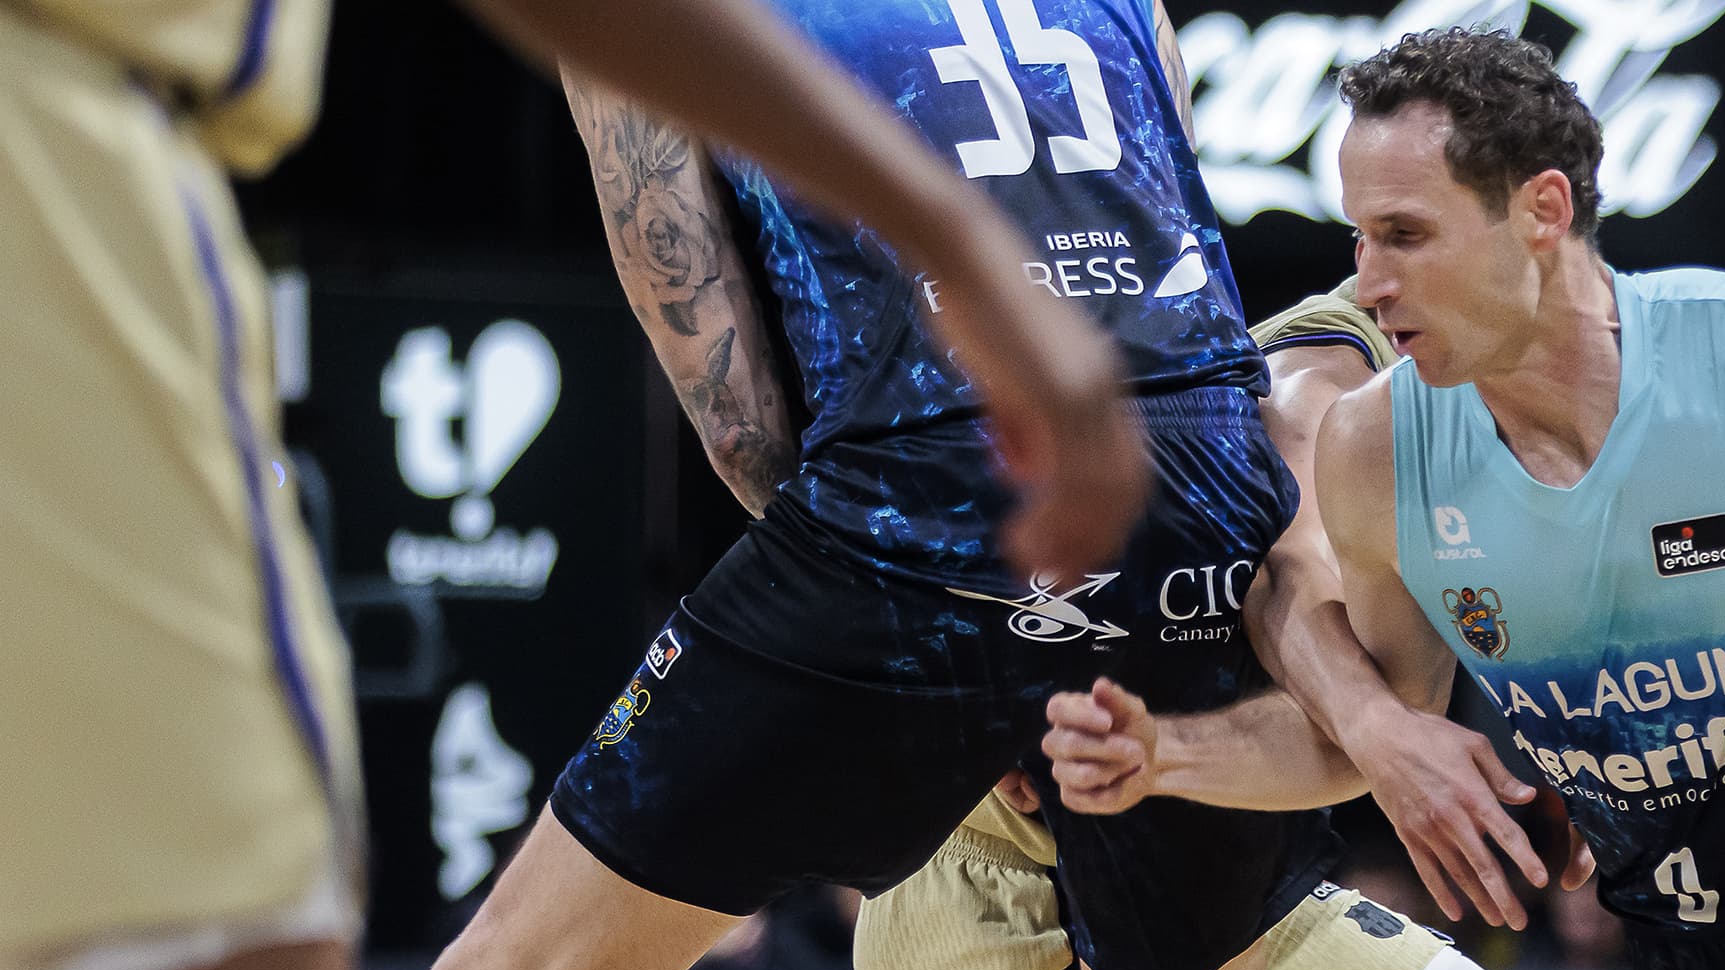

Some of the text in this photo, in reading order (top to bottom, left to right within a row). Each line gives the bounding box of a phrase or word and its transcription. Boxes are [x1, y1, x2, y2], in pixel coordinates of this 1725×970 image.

[928, 0, 1122, 178] 35
[1046, 231, 1131, 250] IBERIA
[923, 257, 1144, 313] ERESS
[1660, 539, 1693, 556] liga
[1159, 560, 1254, 620] CIC
[1160, 624, 1235, 643] Canary
